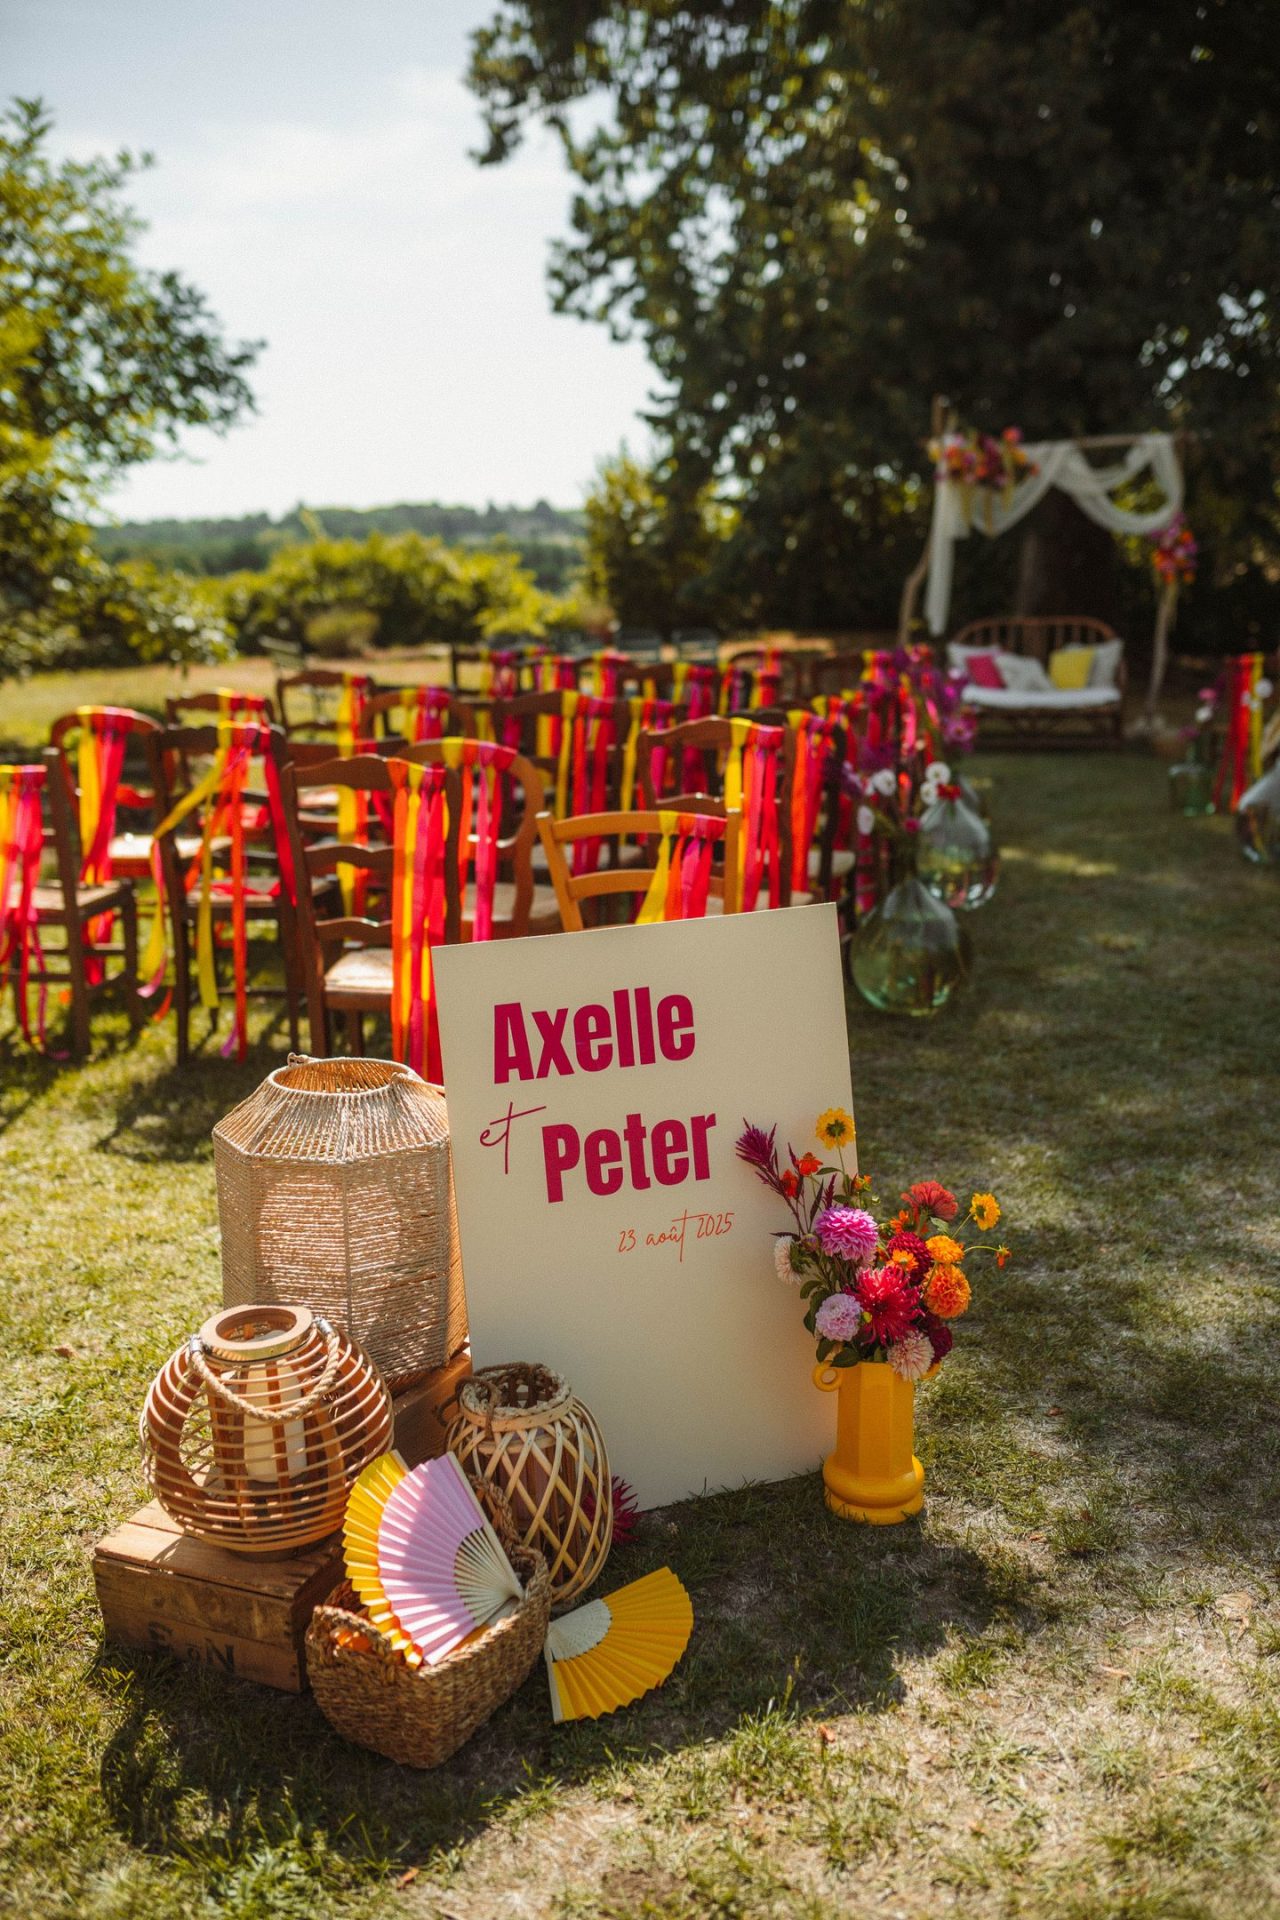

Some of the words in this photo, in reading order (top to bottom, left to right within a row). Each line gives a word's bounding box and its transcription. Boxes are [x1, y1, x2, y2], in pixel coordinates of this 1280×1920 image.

[493, 986, 697, 1085] Axelle
[479, 1101, 547, 1175] et
[541, 1112, 718, 1204] Peter
[618, 1228, 638, 1253] 23
[645, 1209, 709, 1263] août
[696, 1212, 735, 1239] 2025
